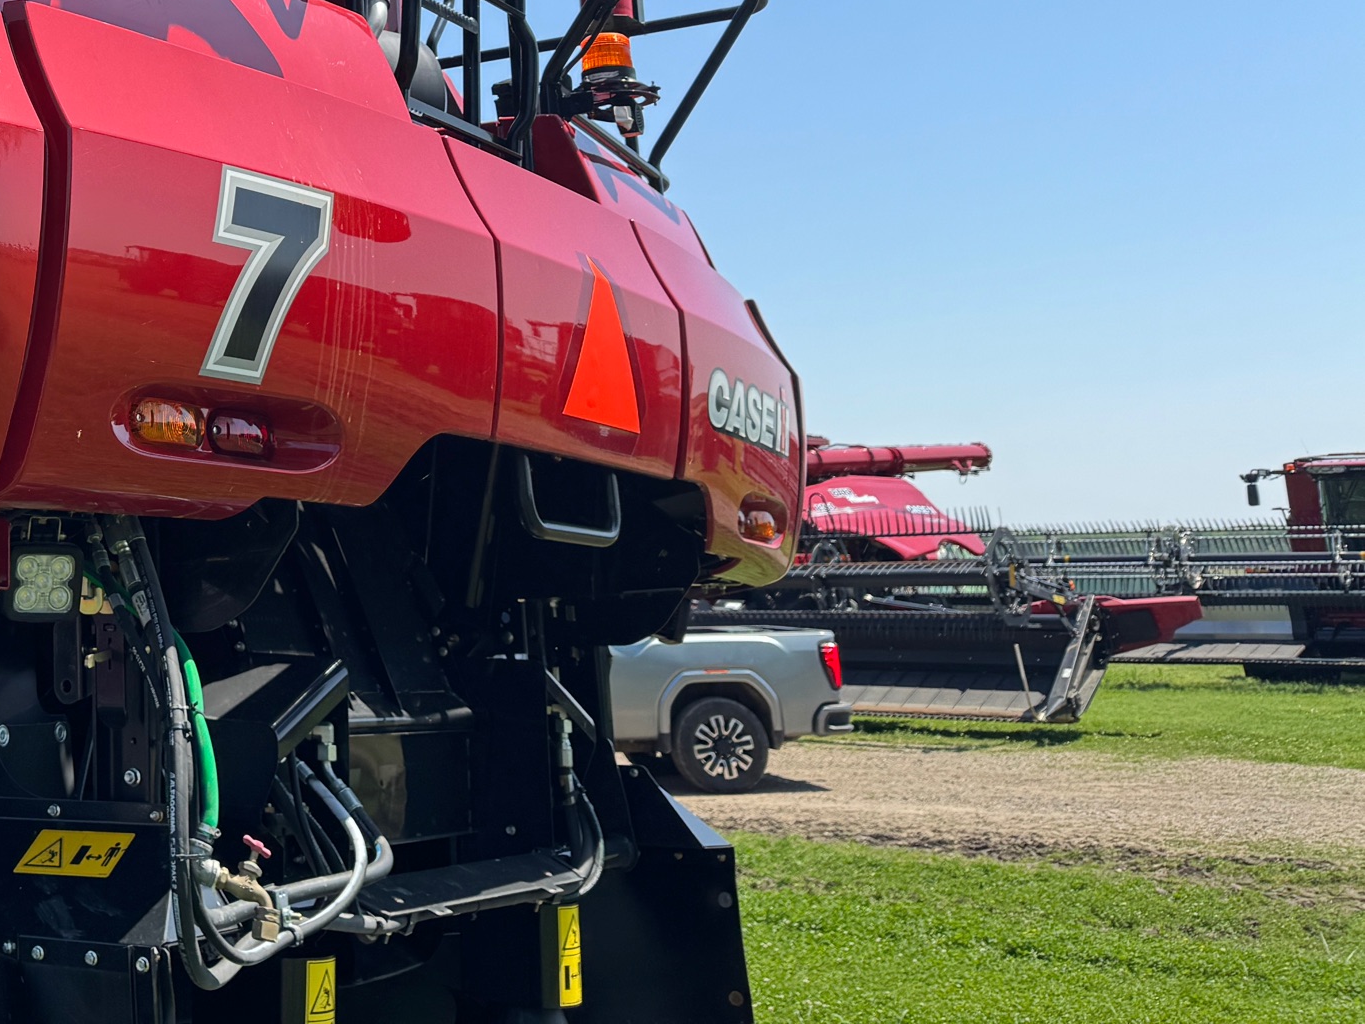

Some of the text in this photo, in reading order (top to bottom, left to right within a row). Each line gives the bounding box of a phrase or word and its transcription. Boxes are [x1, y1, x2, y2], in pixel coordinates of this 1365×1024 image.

[198, 163, 335, 385] 7
[708, 367, 775, 449] CASE
[169, 779, 177, 834] ALFAGOMMA
